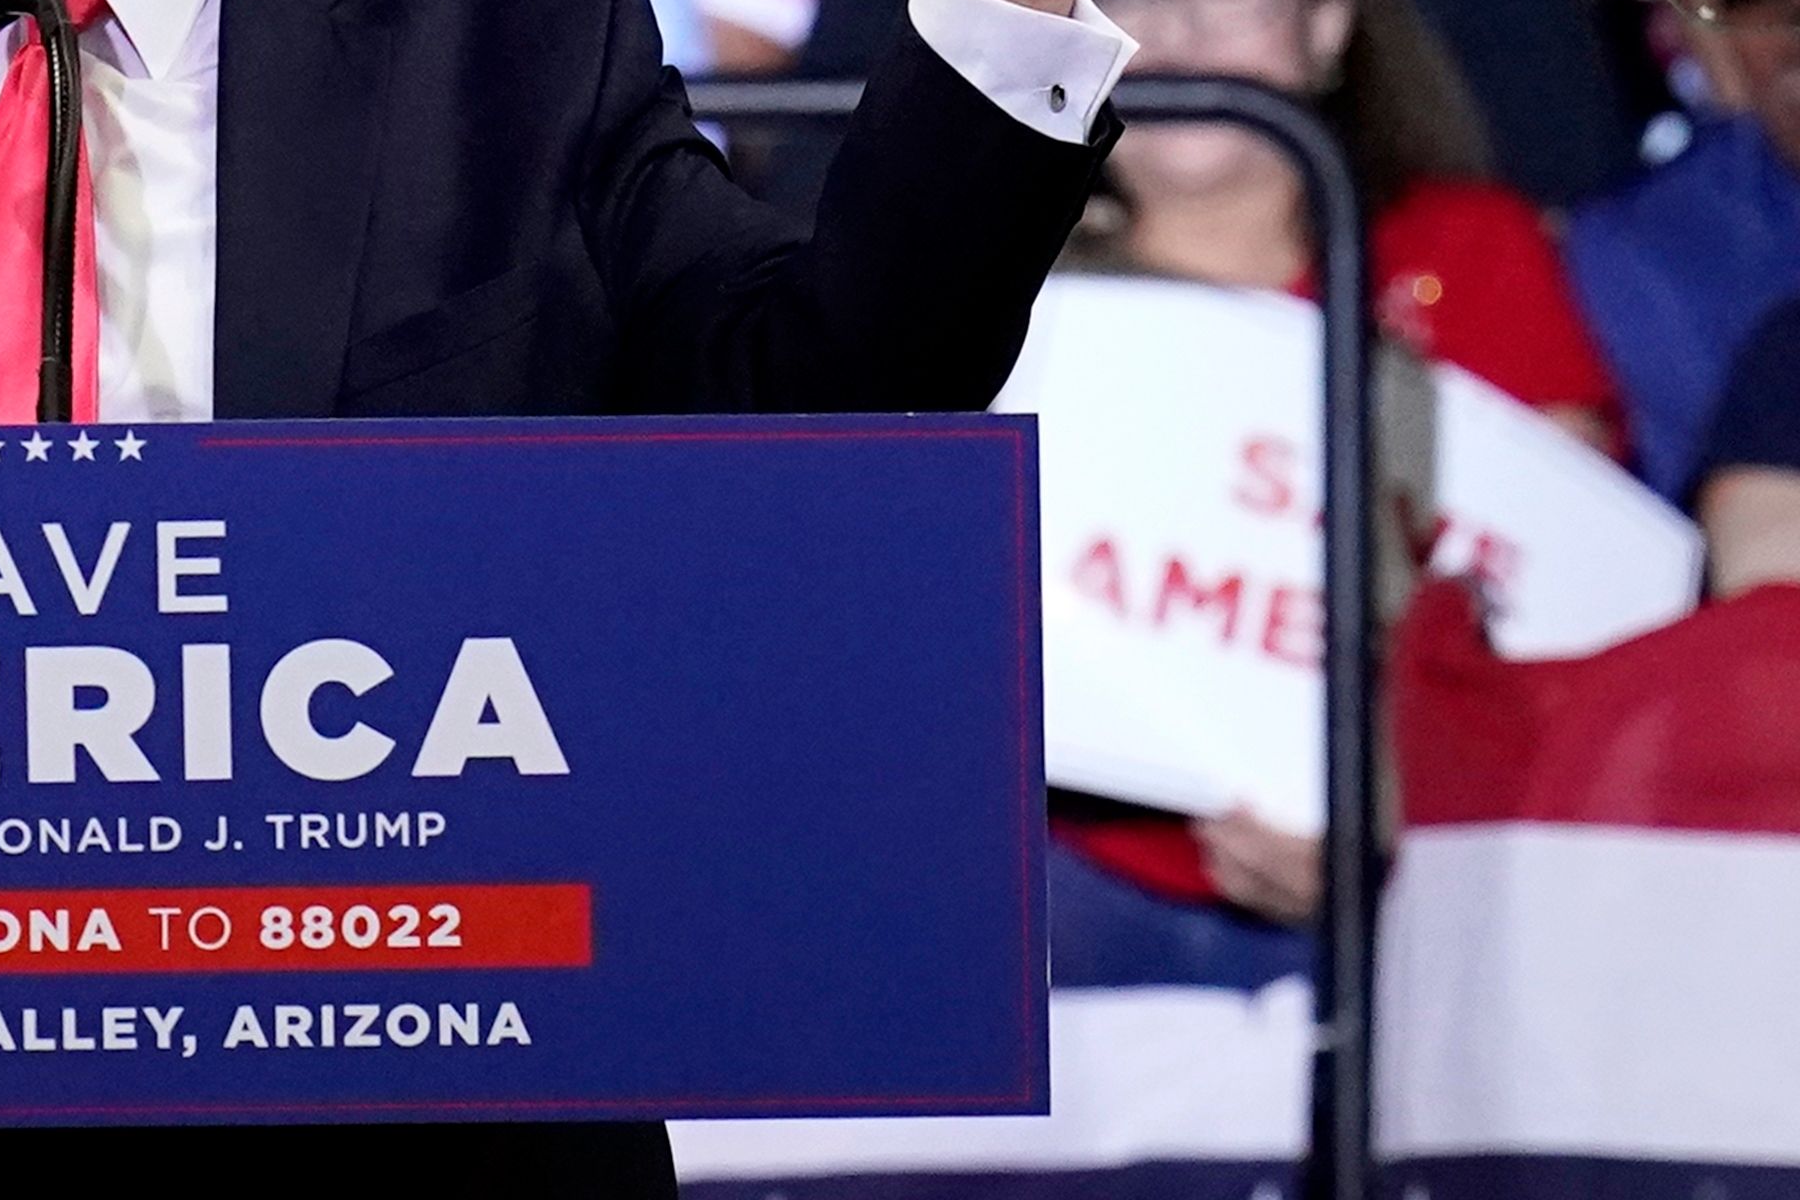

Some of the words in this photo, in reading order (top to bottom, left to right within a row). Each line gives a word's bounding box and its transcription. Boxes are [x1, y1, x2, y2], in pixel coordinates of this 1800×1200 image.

[204, 816, 243, 851] J.
[265, 812, 446, 849] TRUMP
[148, 906, 231, 950] TO
[260, 904, 461, 949] 88022
[223, 1002, 531, 1047] ARIZONA
